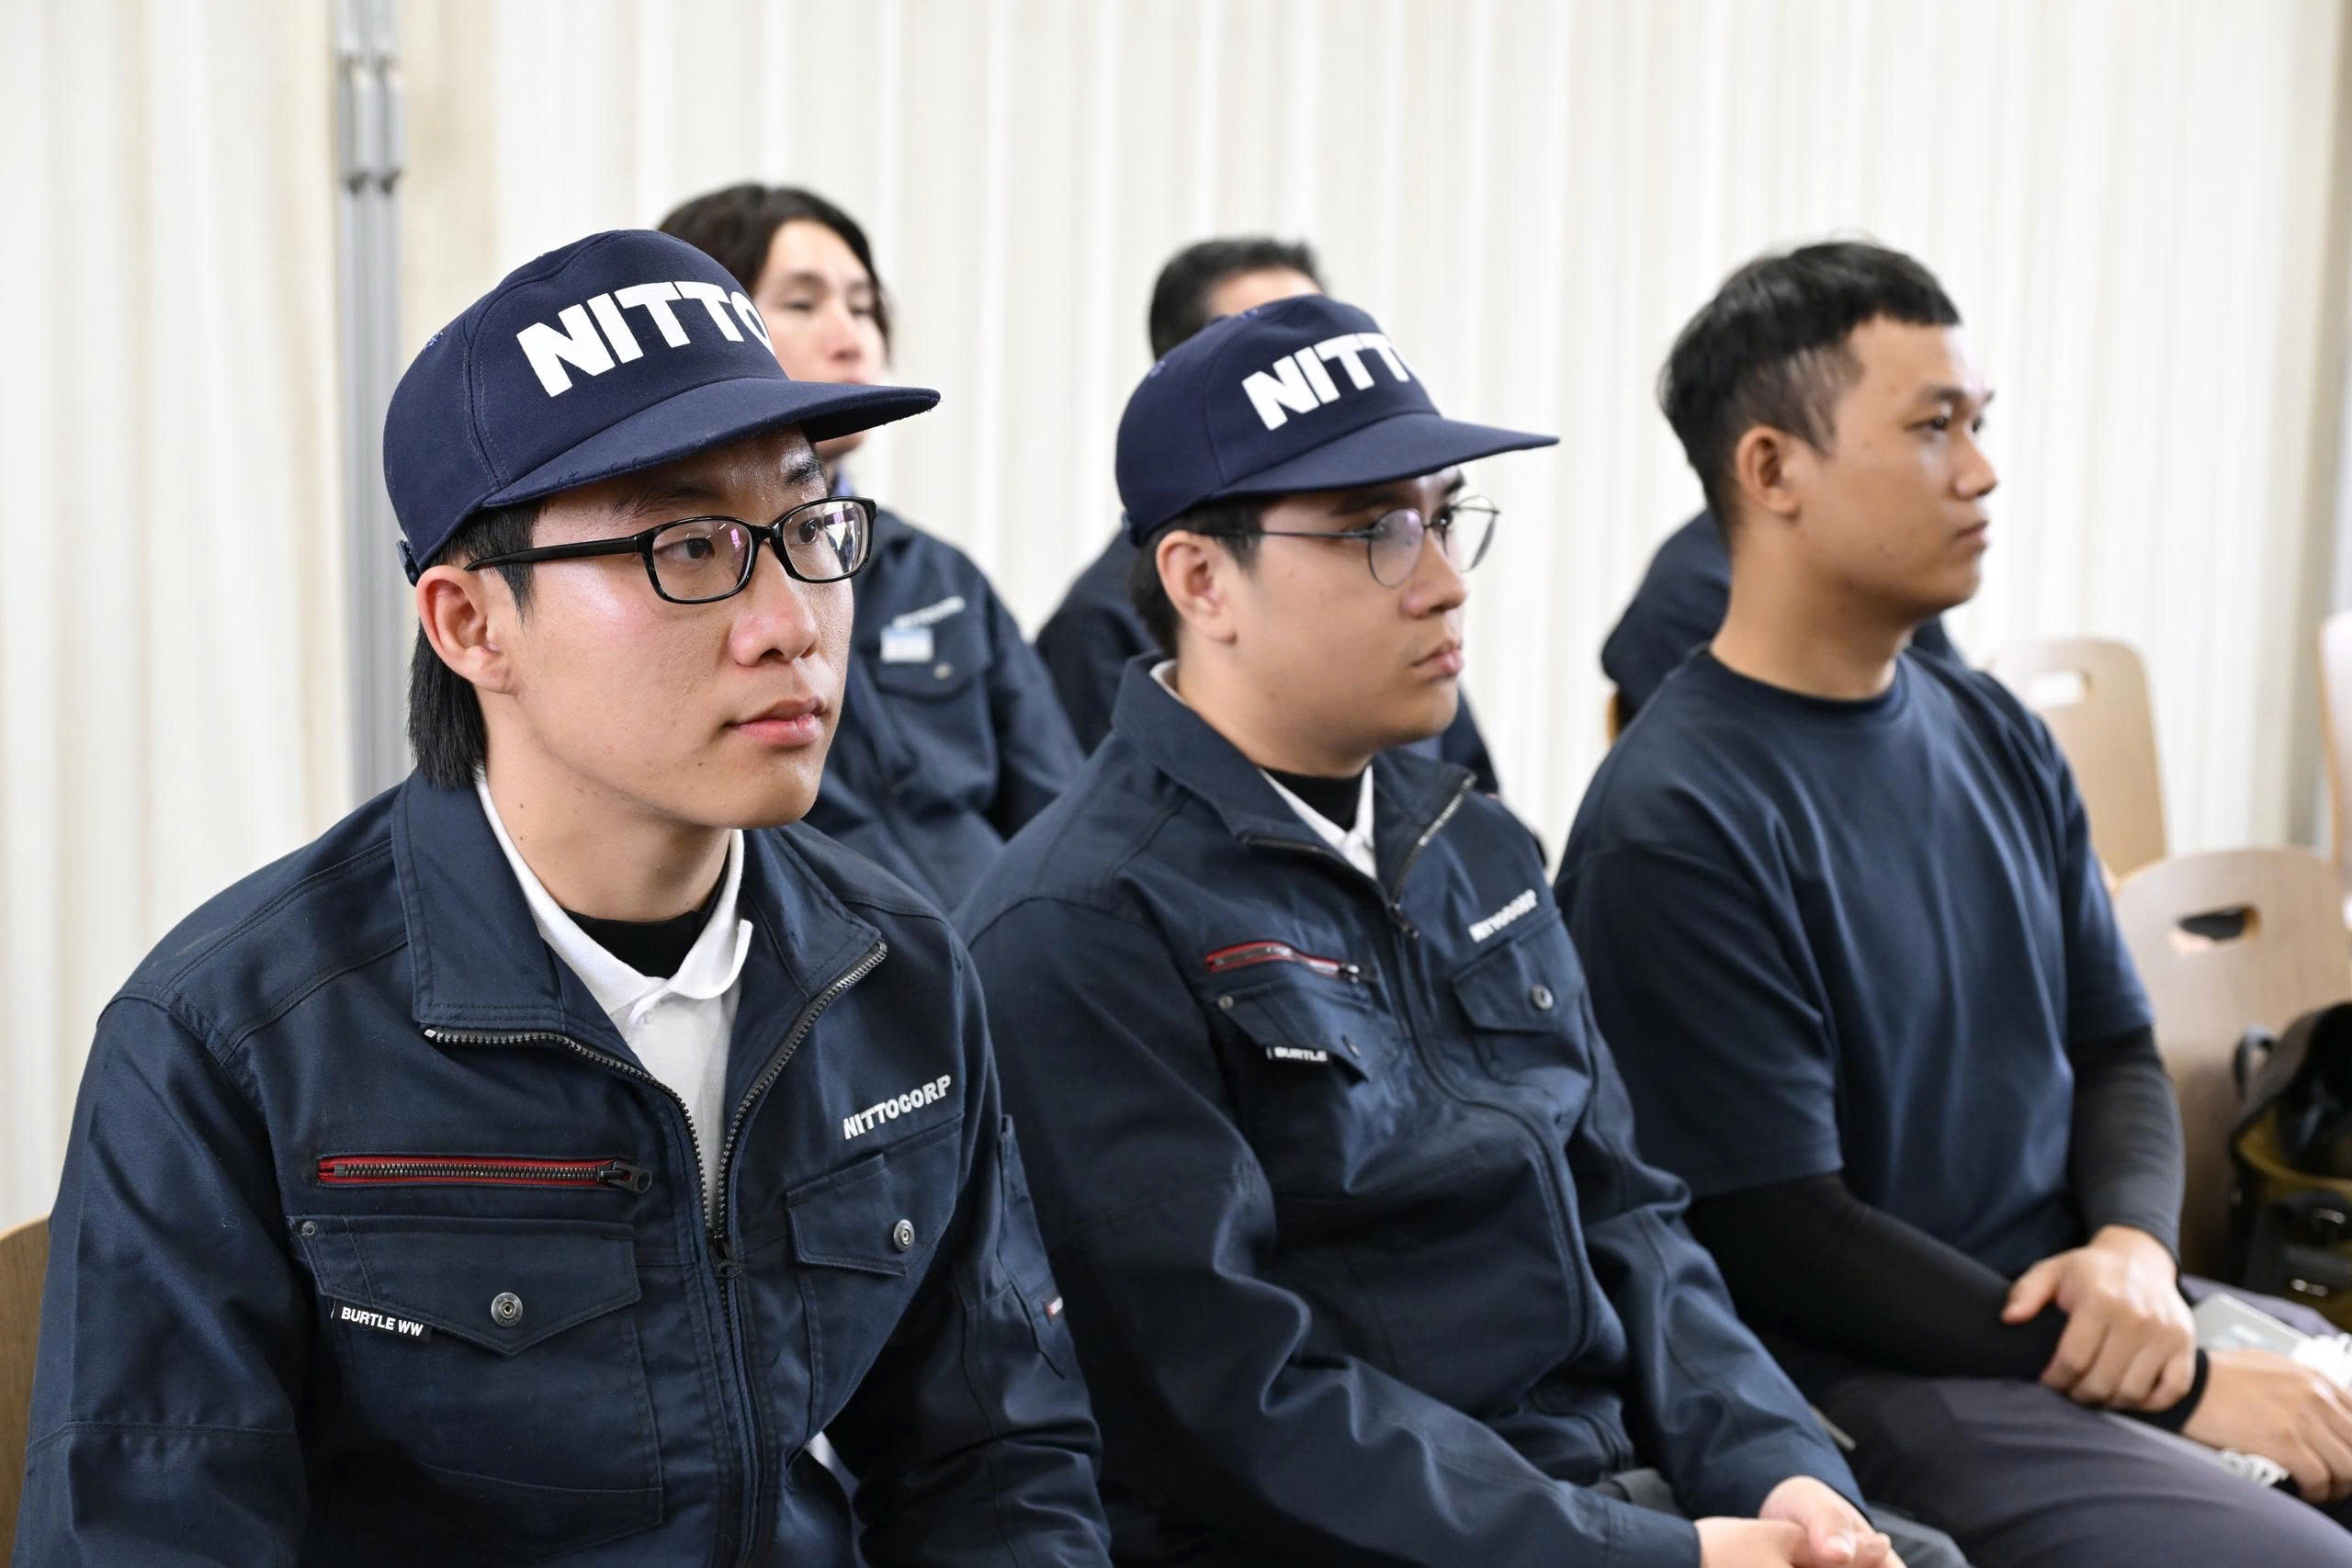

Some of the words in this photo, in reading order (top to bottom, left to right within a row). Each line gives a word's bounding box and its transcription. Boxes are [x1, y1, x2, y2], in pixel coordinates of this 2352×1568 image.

[842, 1074, 951, 1140] NITTOCORP
[340, 1306, 396, 1331] BURTLE
[397, 1319, 424, 1337] WW
